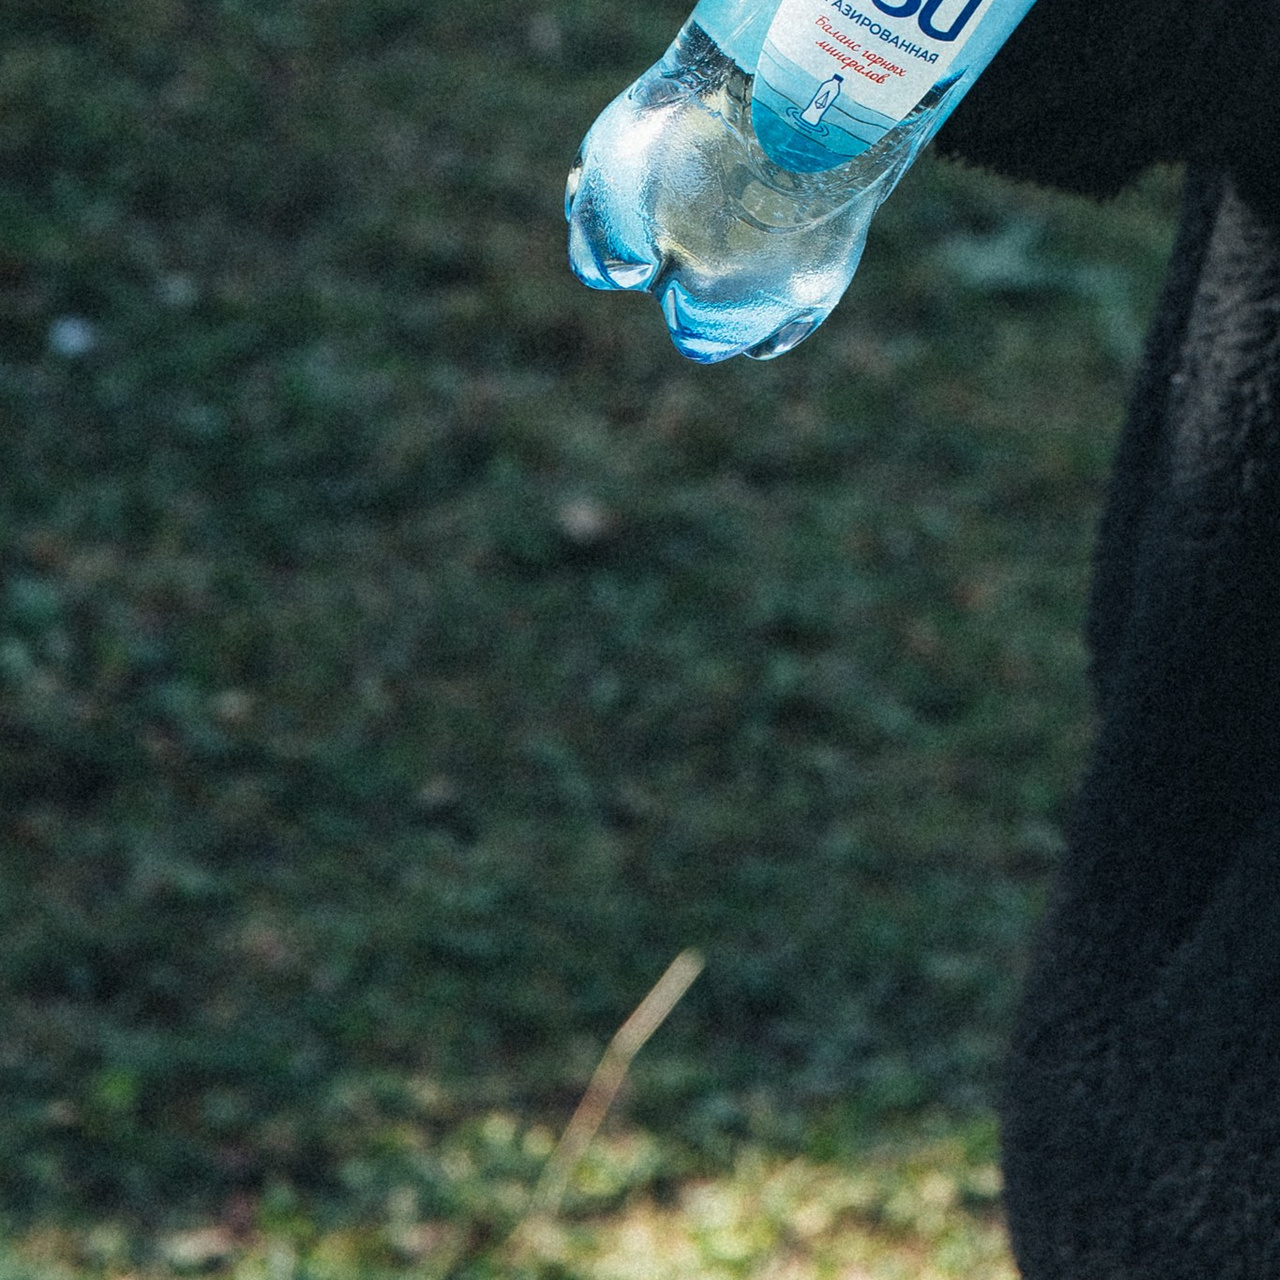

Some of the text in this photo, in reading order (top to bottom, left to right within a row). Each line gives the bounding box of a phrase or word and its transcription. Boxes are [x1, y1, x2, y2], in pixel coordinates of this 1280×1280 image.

[815, 15, 907, 77] Баланс горных
[815, 40, 891, 85] минералов
